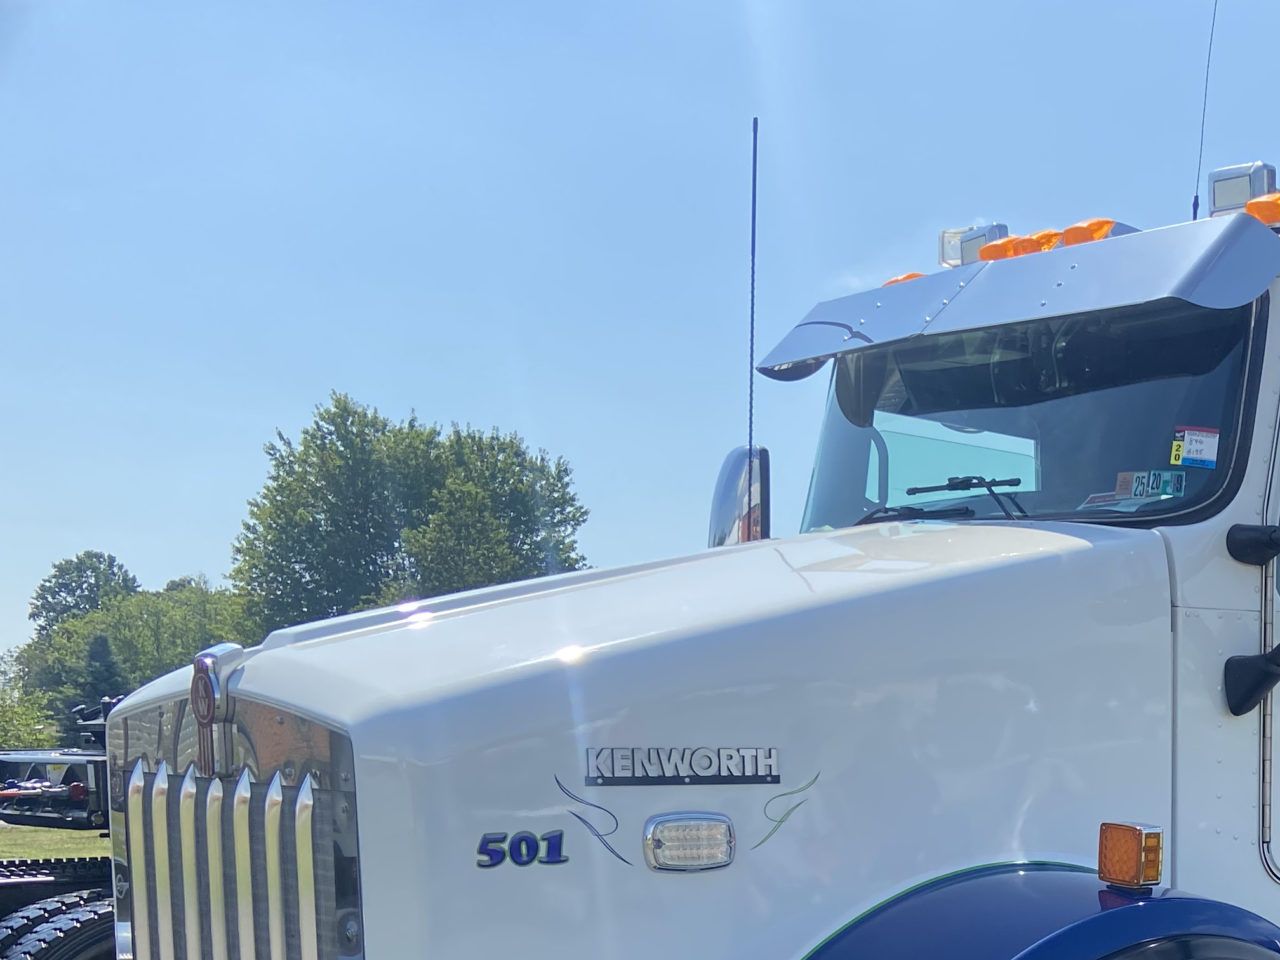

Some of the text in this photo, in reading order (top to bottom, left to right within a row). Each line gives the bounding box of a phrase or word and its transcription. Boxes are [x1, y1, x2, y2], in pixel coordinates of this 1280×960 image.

[1133, 476, 1146, 497] 25
[585, 747, 779, 779] KENWORTH
[475, 829, 570, 869] 501
